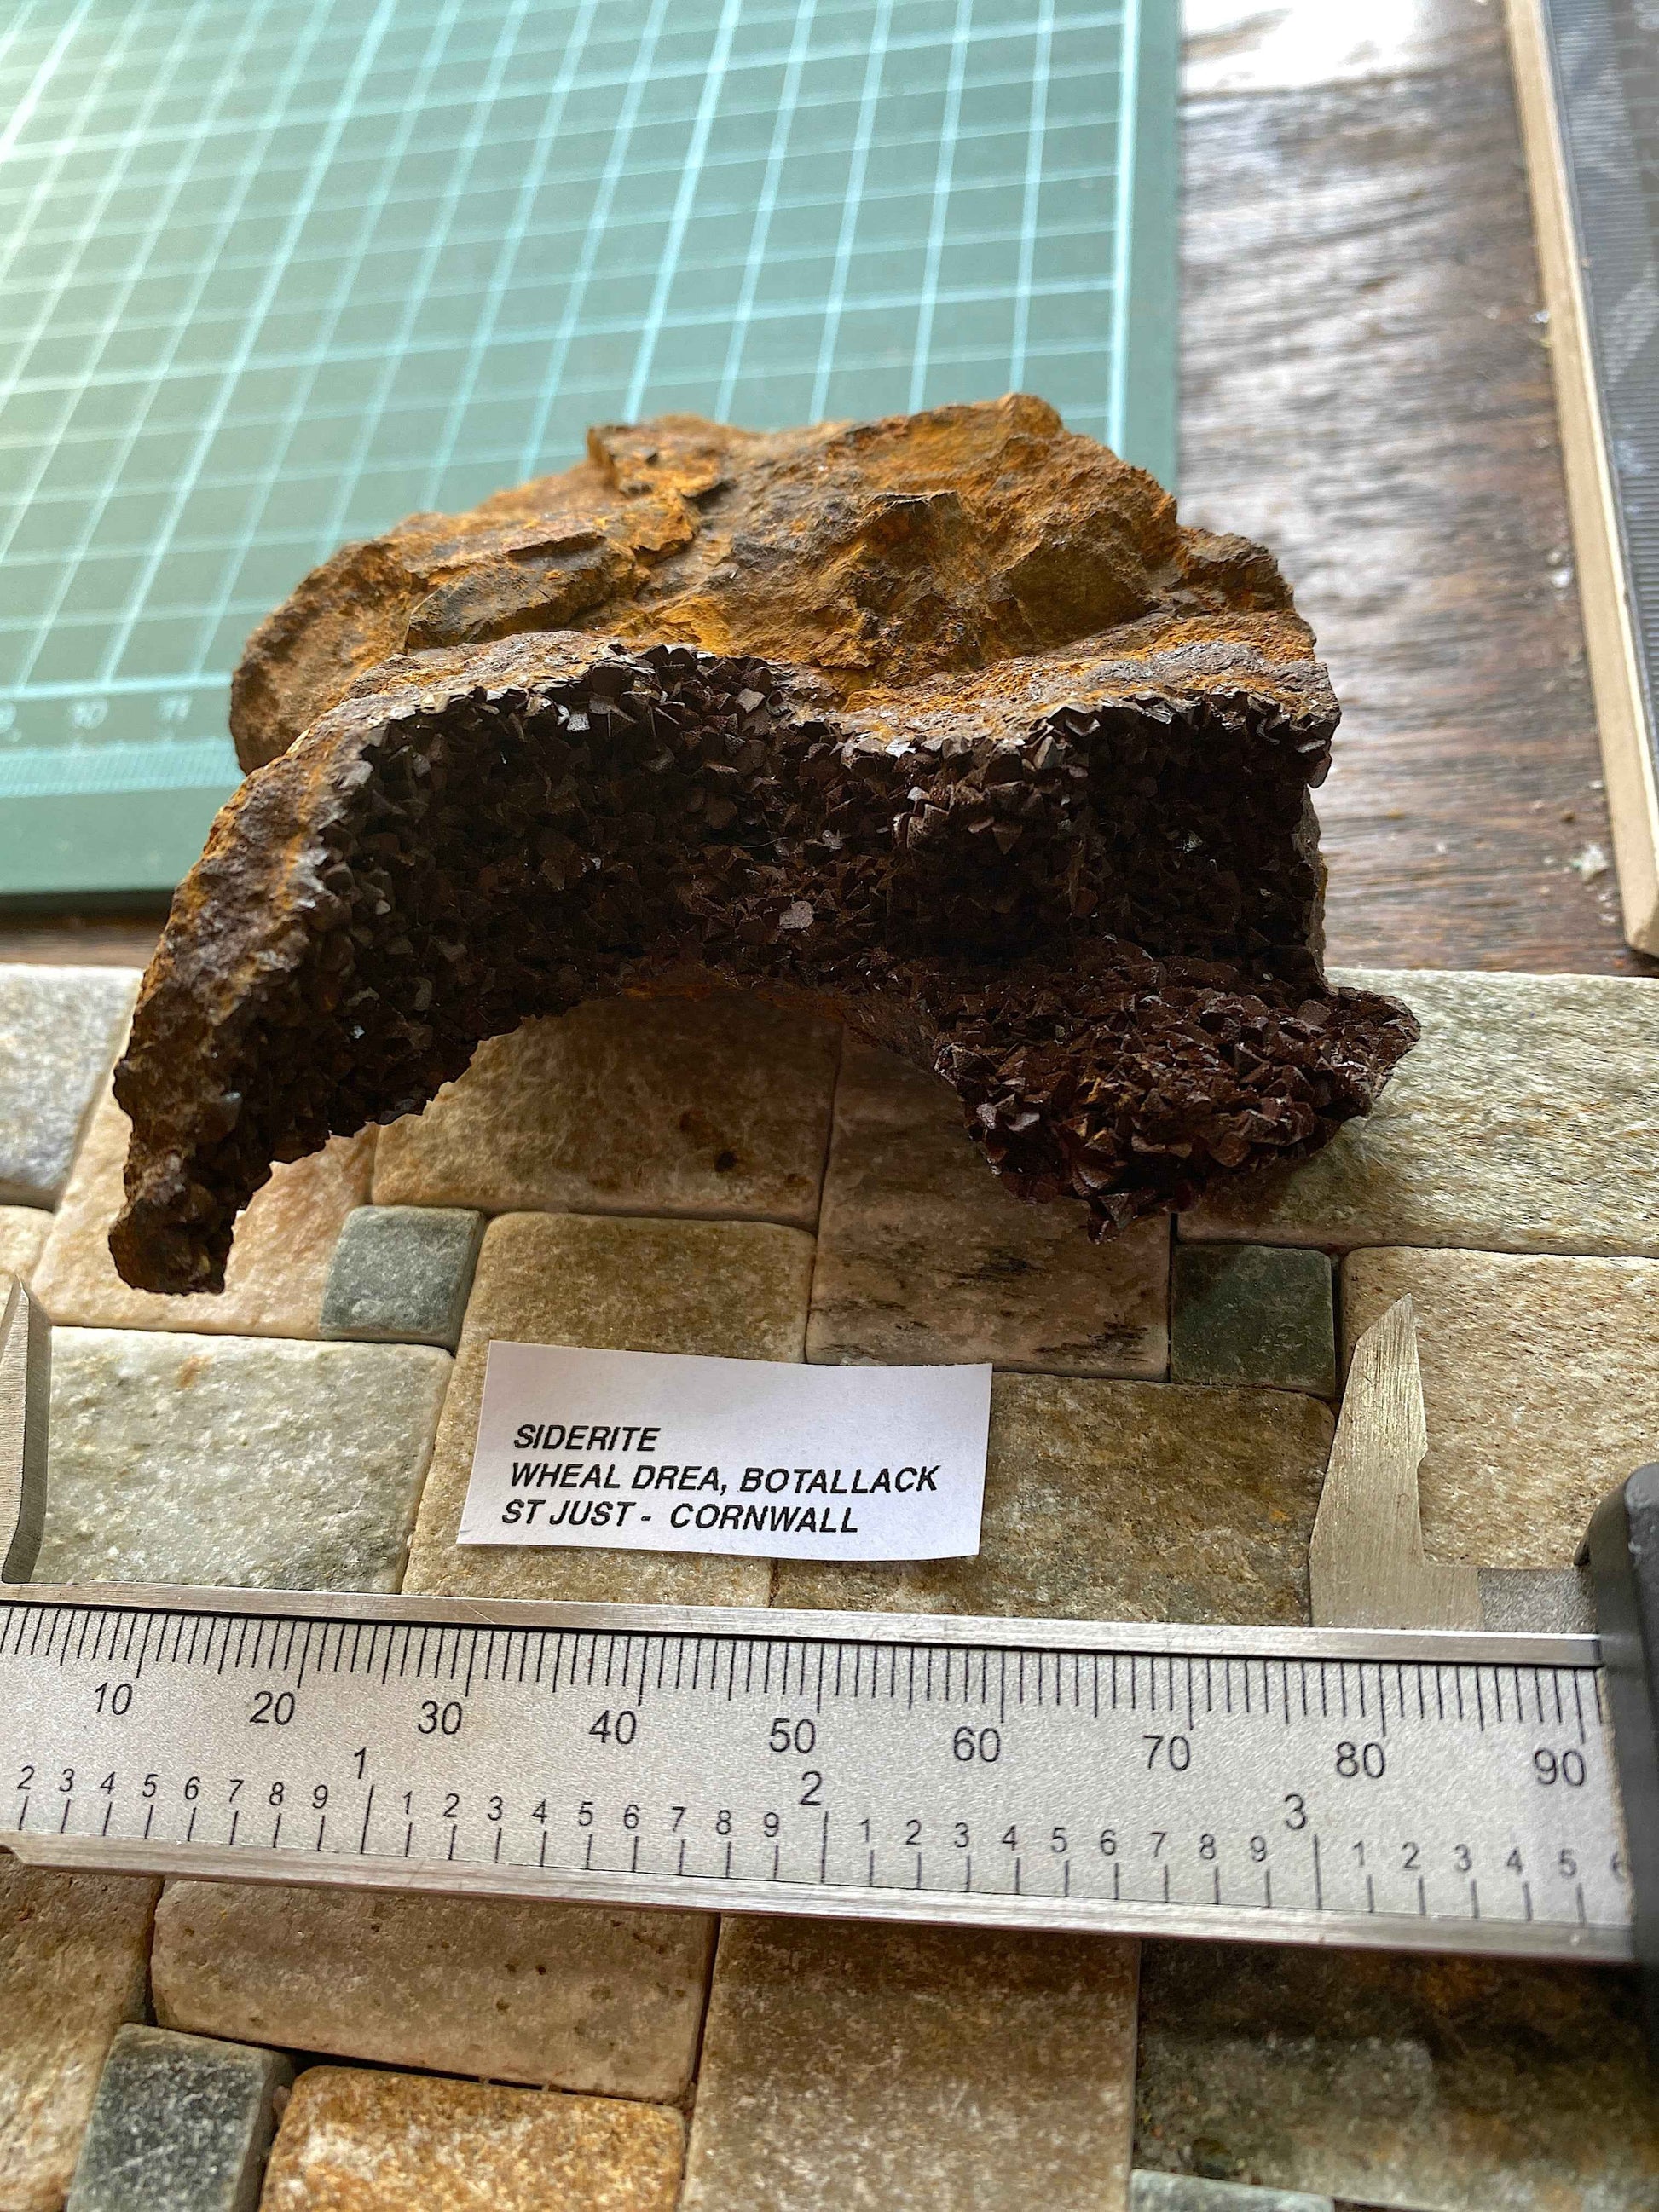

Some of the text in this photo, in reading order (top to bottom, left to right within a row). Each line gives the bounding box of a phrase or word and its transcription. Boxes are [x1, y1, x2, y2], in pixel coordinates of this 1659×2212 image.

[514, 1424, 661, 1451] SIDERITE
[512, 1463, 939, 1494] WHEAL DREA, BOTALLACK
[502, 1499, 546, 1524] ST
[550, 1501, 636, 1526] JUST
[671, 1504, 857, 1533] CORNWALL
[95, 1683, 1585, 1786] 10 20 30 40 50 60 70 80 90
[355, 1747, 1306, 1829] 1 2 3
[17, 1766, 34, 1789] 2
[60, 1769, 74, 1792] 3
[101, 1772, 115, 1794] 4
[142, 1774, 158, 1797] 5
[185, 1777, 199, 1799] 6
[229, 1780, 244, 1802] 7
[269, 1782, 284, 1805] 8
[313, 1785, 328, 1809] 9
[404, 1792, 412, 1815] 1
[443, 1793, 459, 1818] 2
[488, 1796, 503, 1821] 3
[532, 1801, 546, 1822] 4
[579, 1802, 592, 1826] 5
[624, 1805, 639, 1828] 6
[670, 1806, 686, 1832] 7
[716, 1811, 731, 1834] 8
[765, 1812, 778, 1837] 9
[861, 1819, 869, 1841] 1
[906, 1820, 921, 1845] 2
[956, 1822, 968, 1848] 3
[1003, 1826, 1016, 1851] 4
[1053, 1828, 1066, 1852] 5
[1101, 1830, 1115, 1855] 6
[1151, 1832, 1165, 1857] 7
[1200, 1834, 1215, 1859] 8
[1251, 1837, 1265, 1862] 9
[1354, 1841, 1363, 1865] 1
[1403, 1844, 1418, 1868] 2
[1455, 1845, 1471, 1871] 3
[1506, 1848, 1523, 1874] 4
[1560, 1851, 1575, 1875] 5
